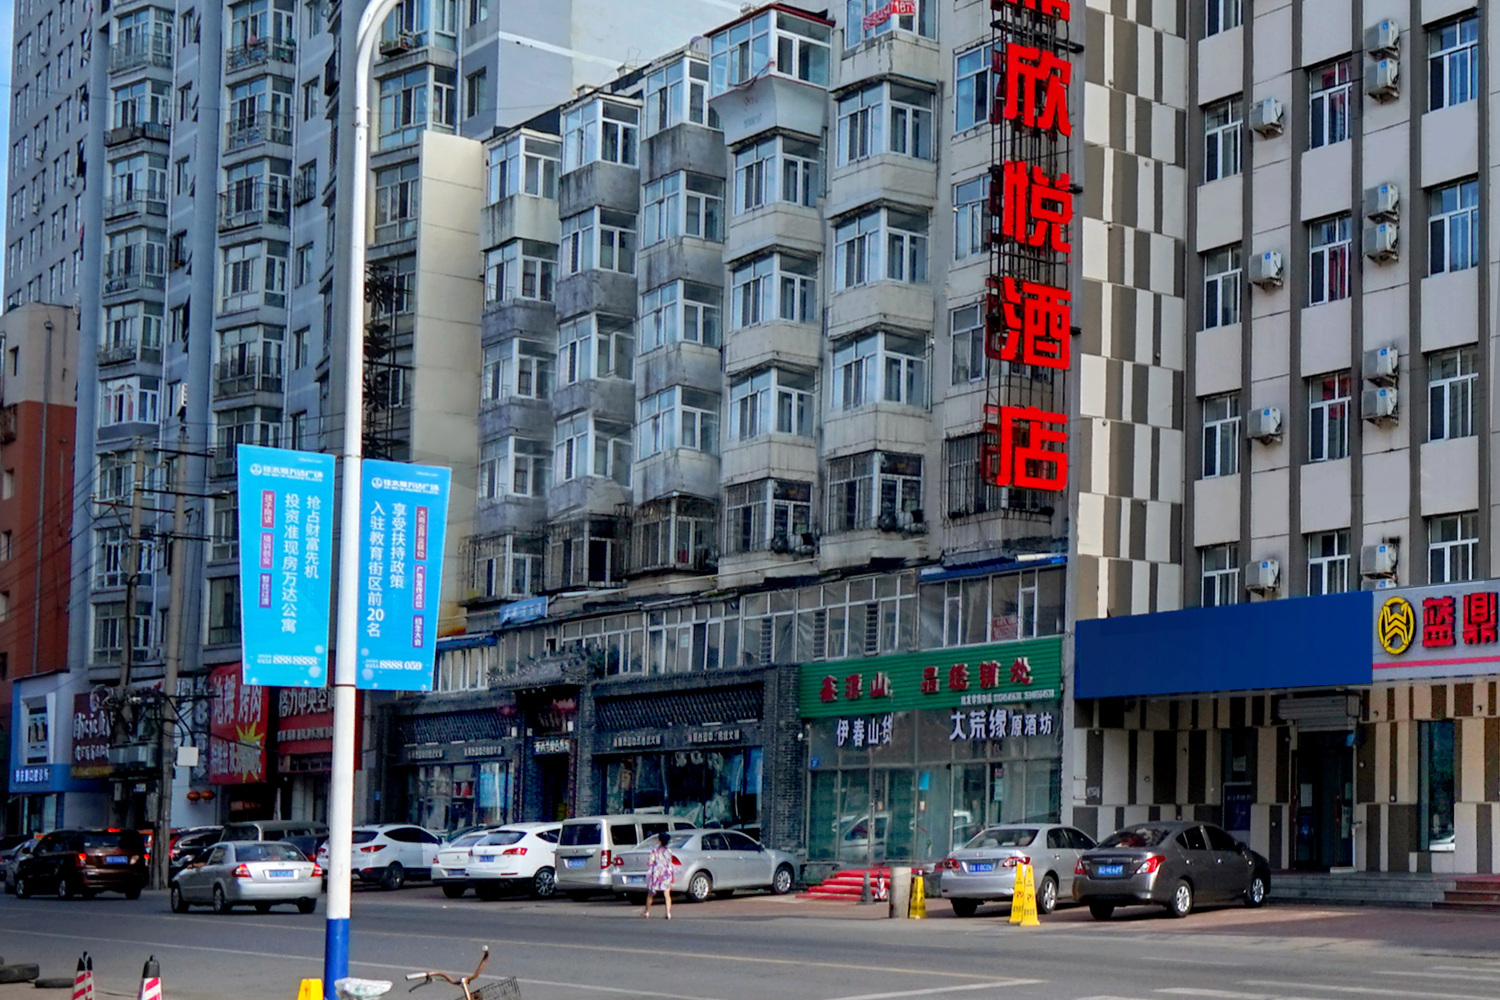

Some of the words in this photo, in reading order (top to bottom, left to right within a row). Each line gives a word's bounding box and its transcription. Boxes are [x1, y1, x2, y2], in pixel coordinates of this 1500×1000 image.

[281, 493, 300, 634] 投资准现房万达公寓
[304, 495, 321, 579] 抢占财富先机
[366, 500, 386, 638] 入驻教育街区前20名
[390, 502, 407, 589] 享受扶持政策
[837, 712, 894, 747] 伊春山货
[949, 708, 1007, 740] 大荒缘
[1010, 711, 1053, 737] 原酒坊
